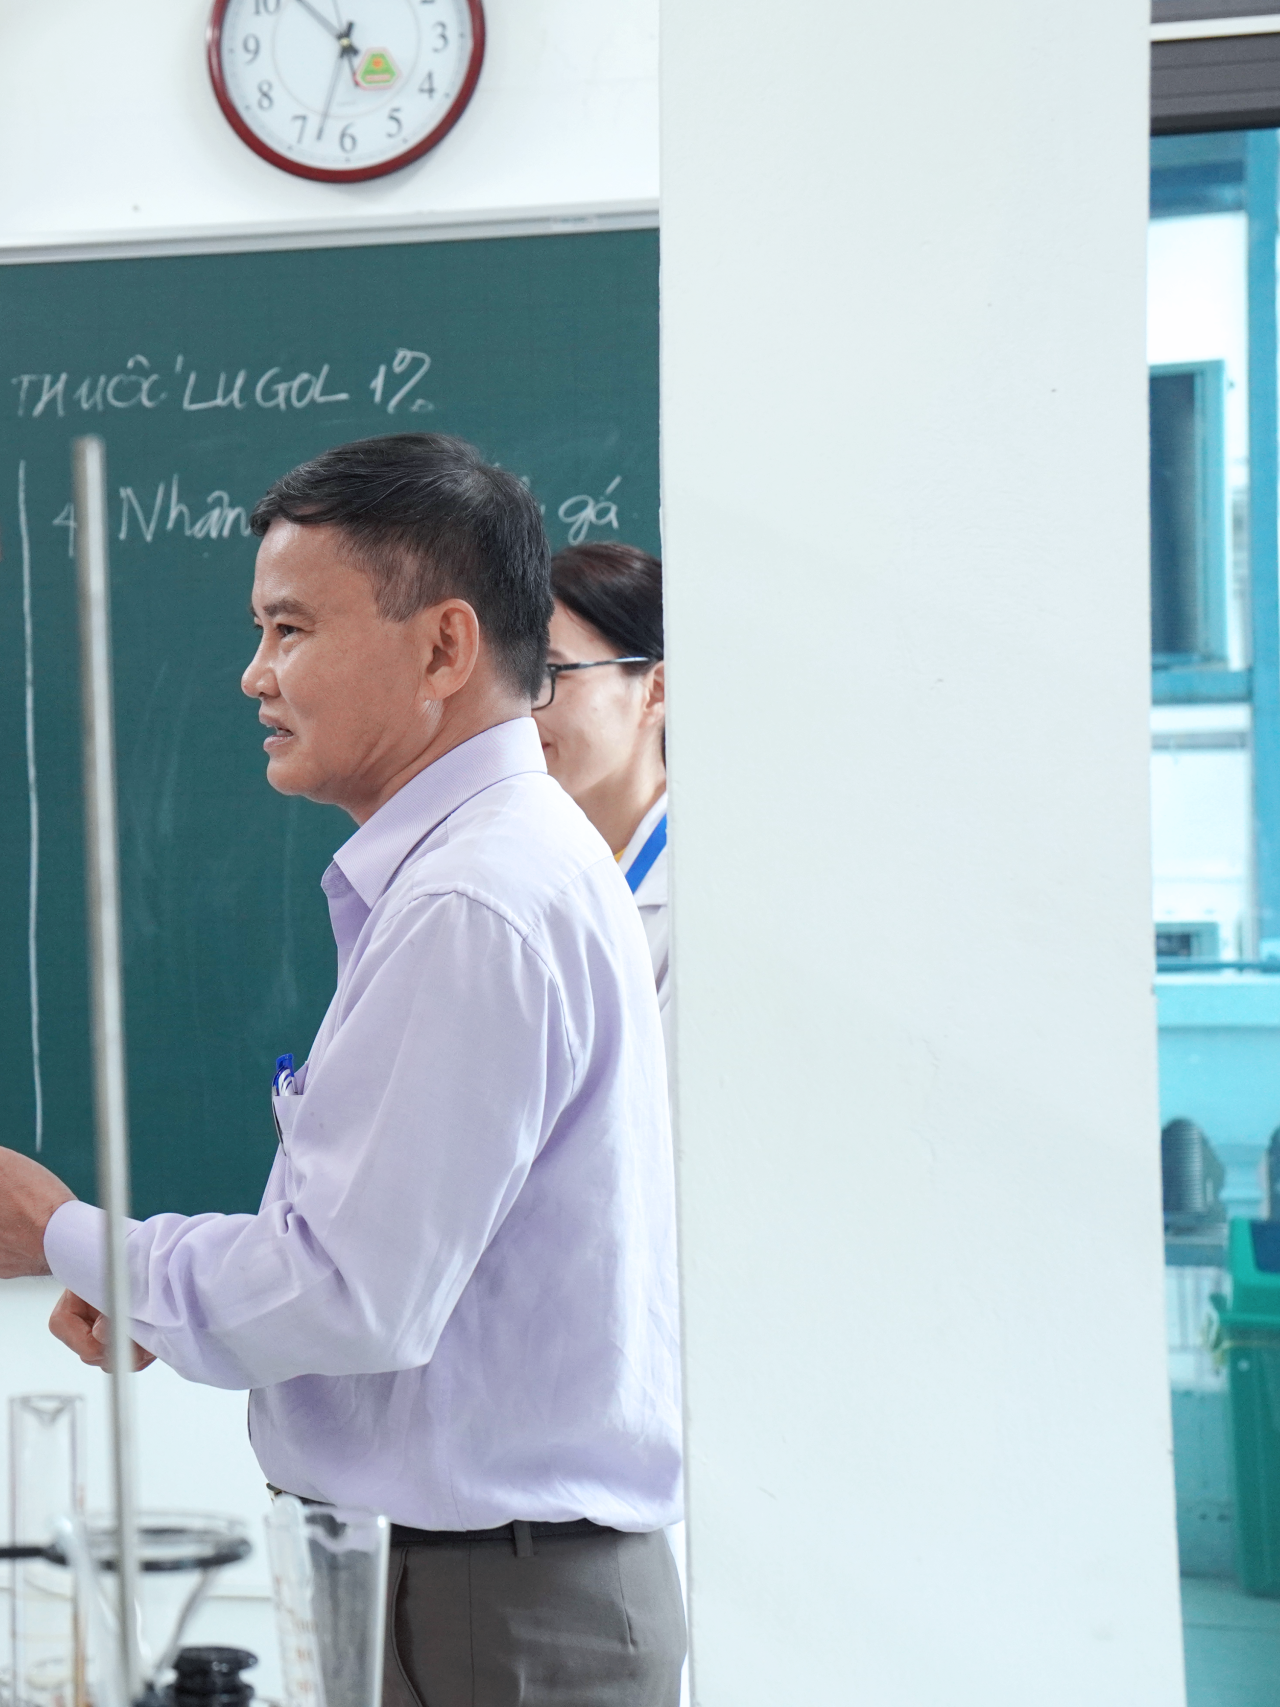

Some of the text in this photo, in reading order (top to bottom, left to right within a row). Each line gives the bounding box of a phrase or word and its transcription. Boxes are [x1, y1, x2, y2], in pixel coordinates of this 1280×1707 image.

[242, 34, 261, 65] 9
[431, 21, 449, 52] 3
[257, 79, 274, 111] 8
[418, 70, 436, 99] 4
[291, 115, 308, 144] 7
[339, 123, 357, 153] 6
[387, 107, 403, 138] 5
[182, 369, 350, 412] LUGOL
[370, 347, 435, 414] 1%
